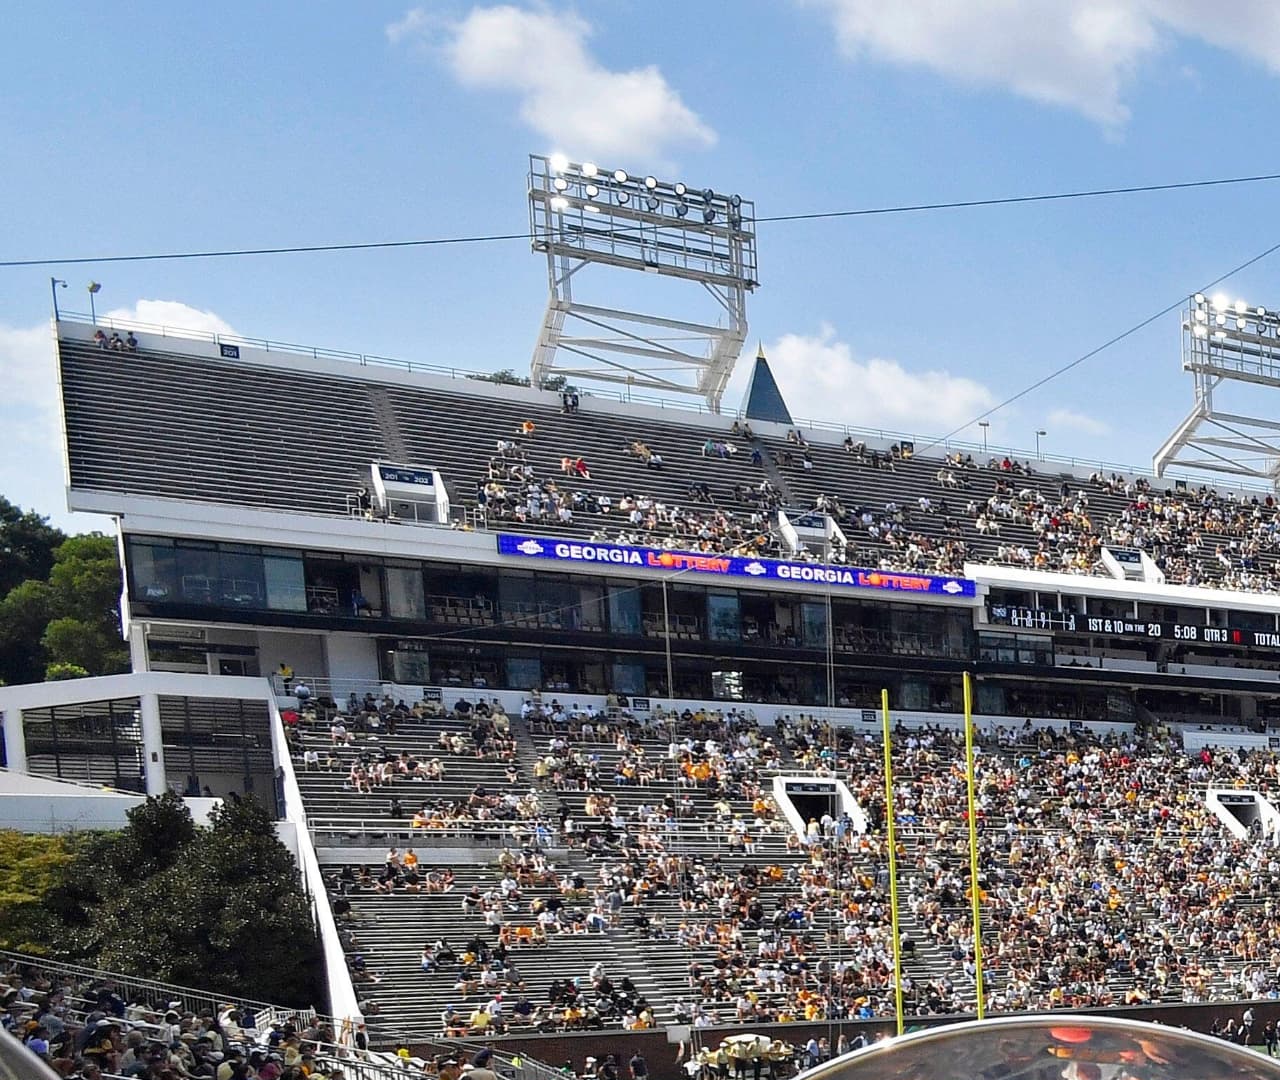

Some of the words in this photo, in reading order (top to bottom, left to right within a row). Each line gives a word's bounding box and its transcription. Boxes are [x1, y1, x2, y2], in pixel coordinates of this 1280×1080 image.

[555, 543, 643, 564] GEORGIA
[647, 551, 731, 573] LOTTERY
[776, 565, 854, 585] GEORGIA
[858, 572, 932, 591] LOTTERY
[1088, 618, 1103, 631] 1ST
[1105, 619, 1113, 632] &
[1114, 620, 1124, 633] 10
[1148, 623, 1161, 636] 20
[1174, 624, 1197, 640] 5:08
[1204, 628, 1220, 642] QTR
[1221, 629, 1228, 642] 3
[1254, 632, 1280, 648] TOTAL
